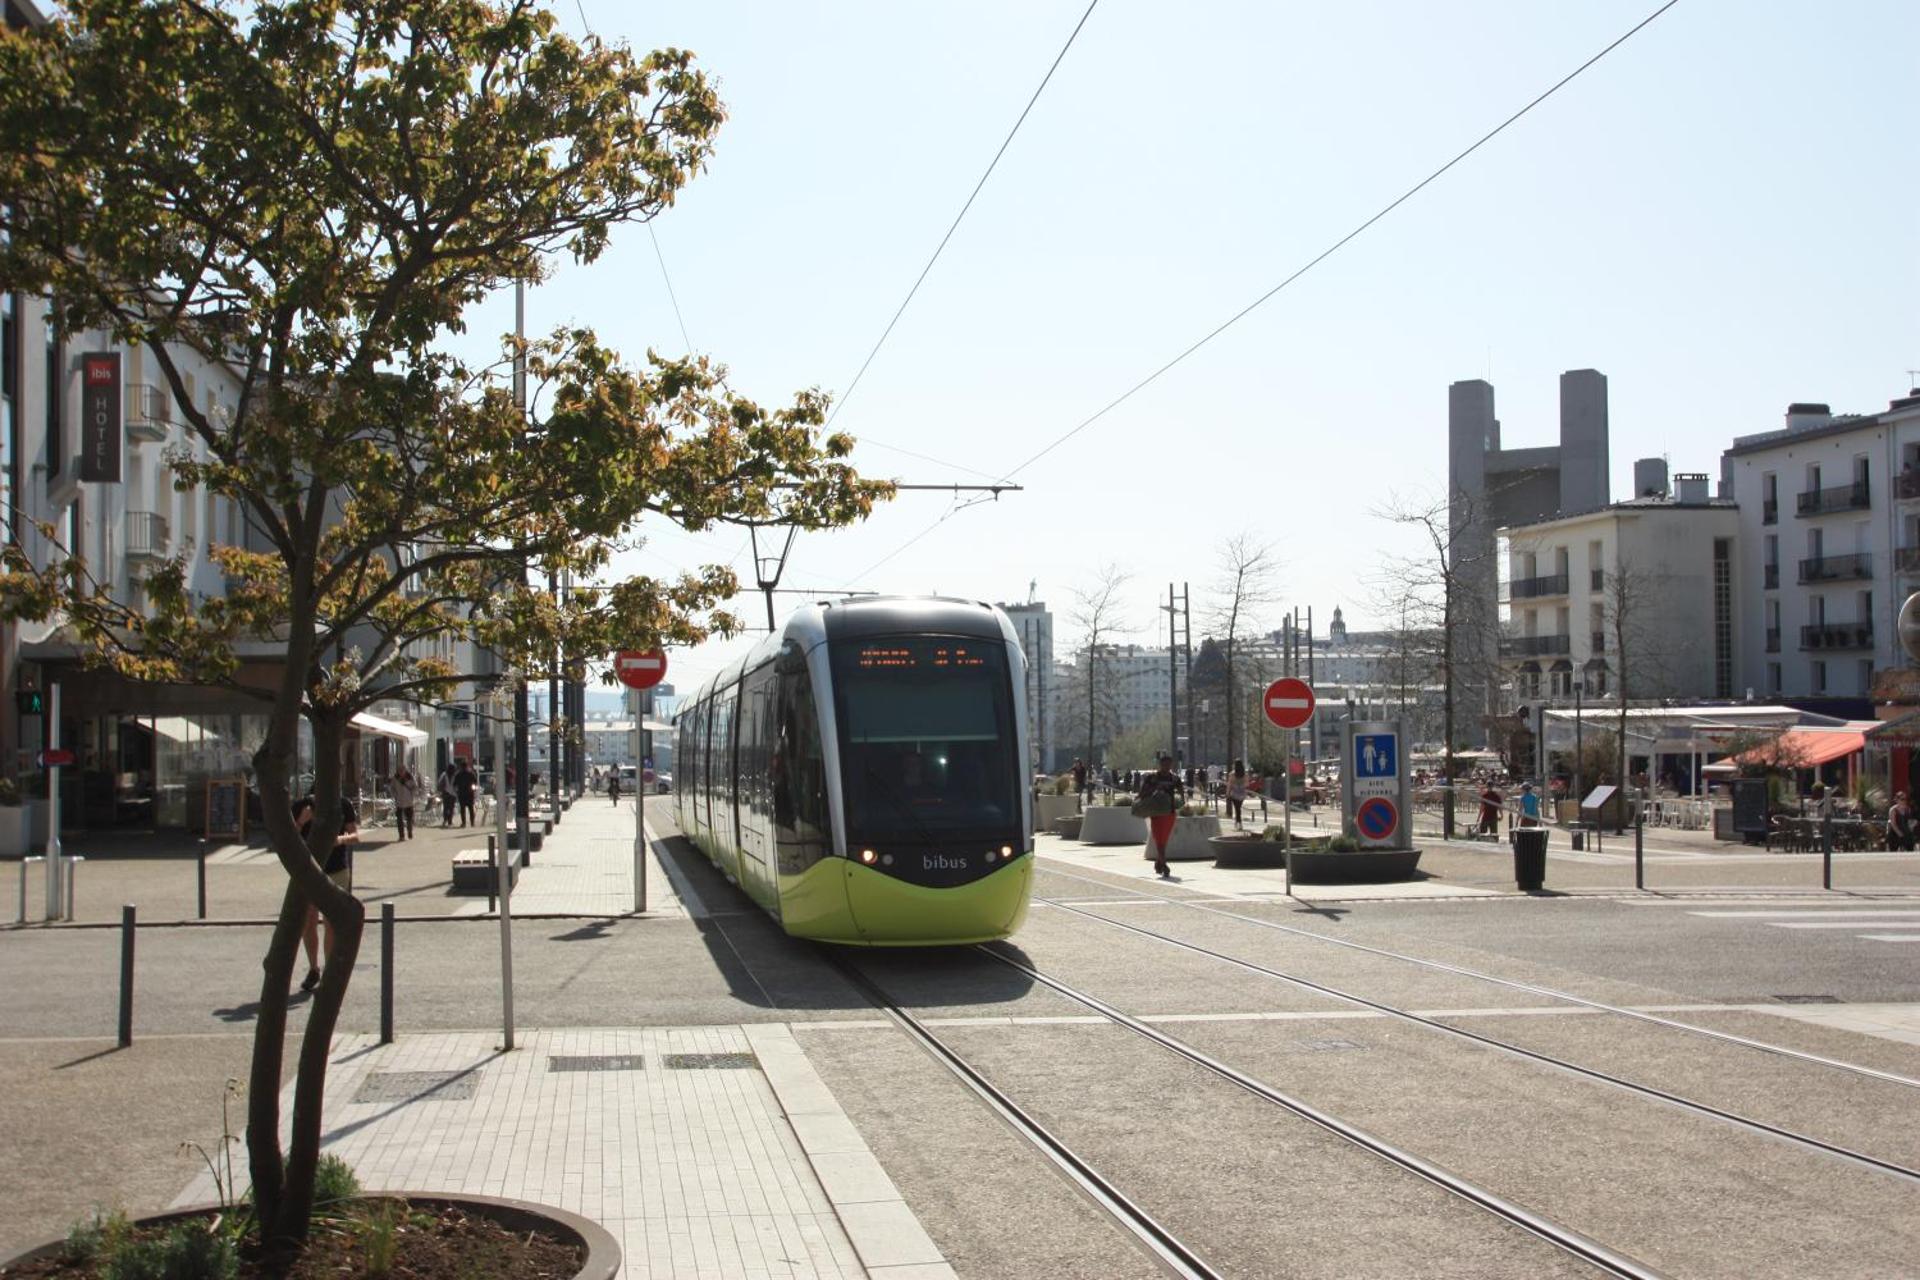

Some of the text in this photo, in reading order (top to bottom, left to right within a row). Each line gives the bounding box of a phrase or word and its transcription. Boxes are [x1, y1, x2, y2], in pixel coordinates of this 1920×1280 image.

[91, 367, 111, 379] ibis
[96, 397, 107, 472] HOTEL
[923, 855, 967, 869] bibus
